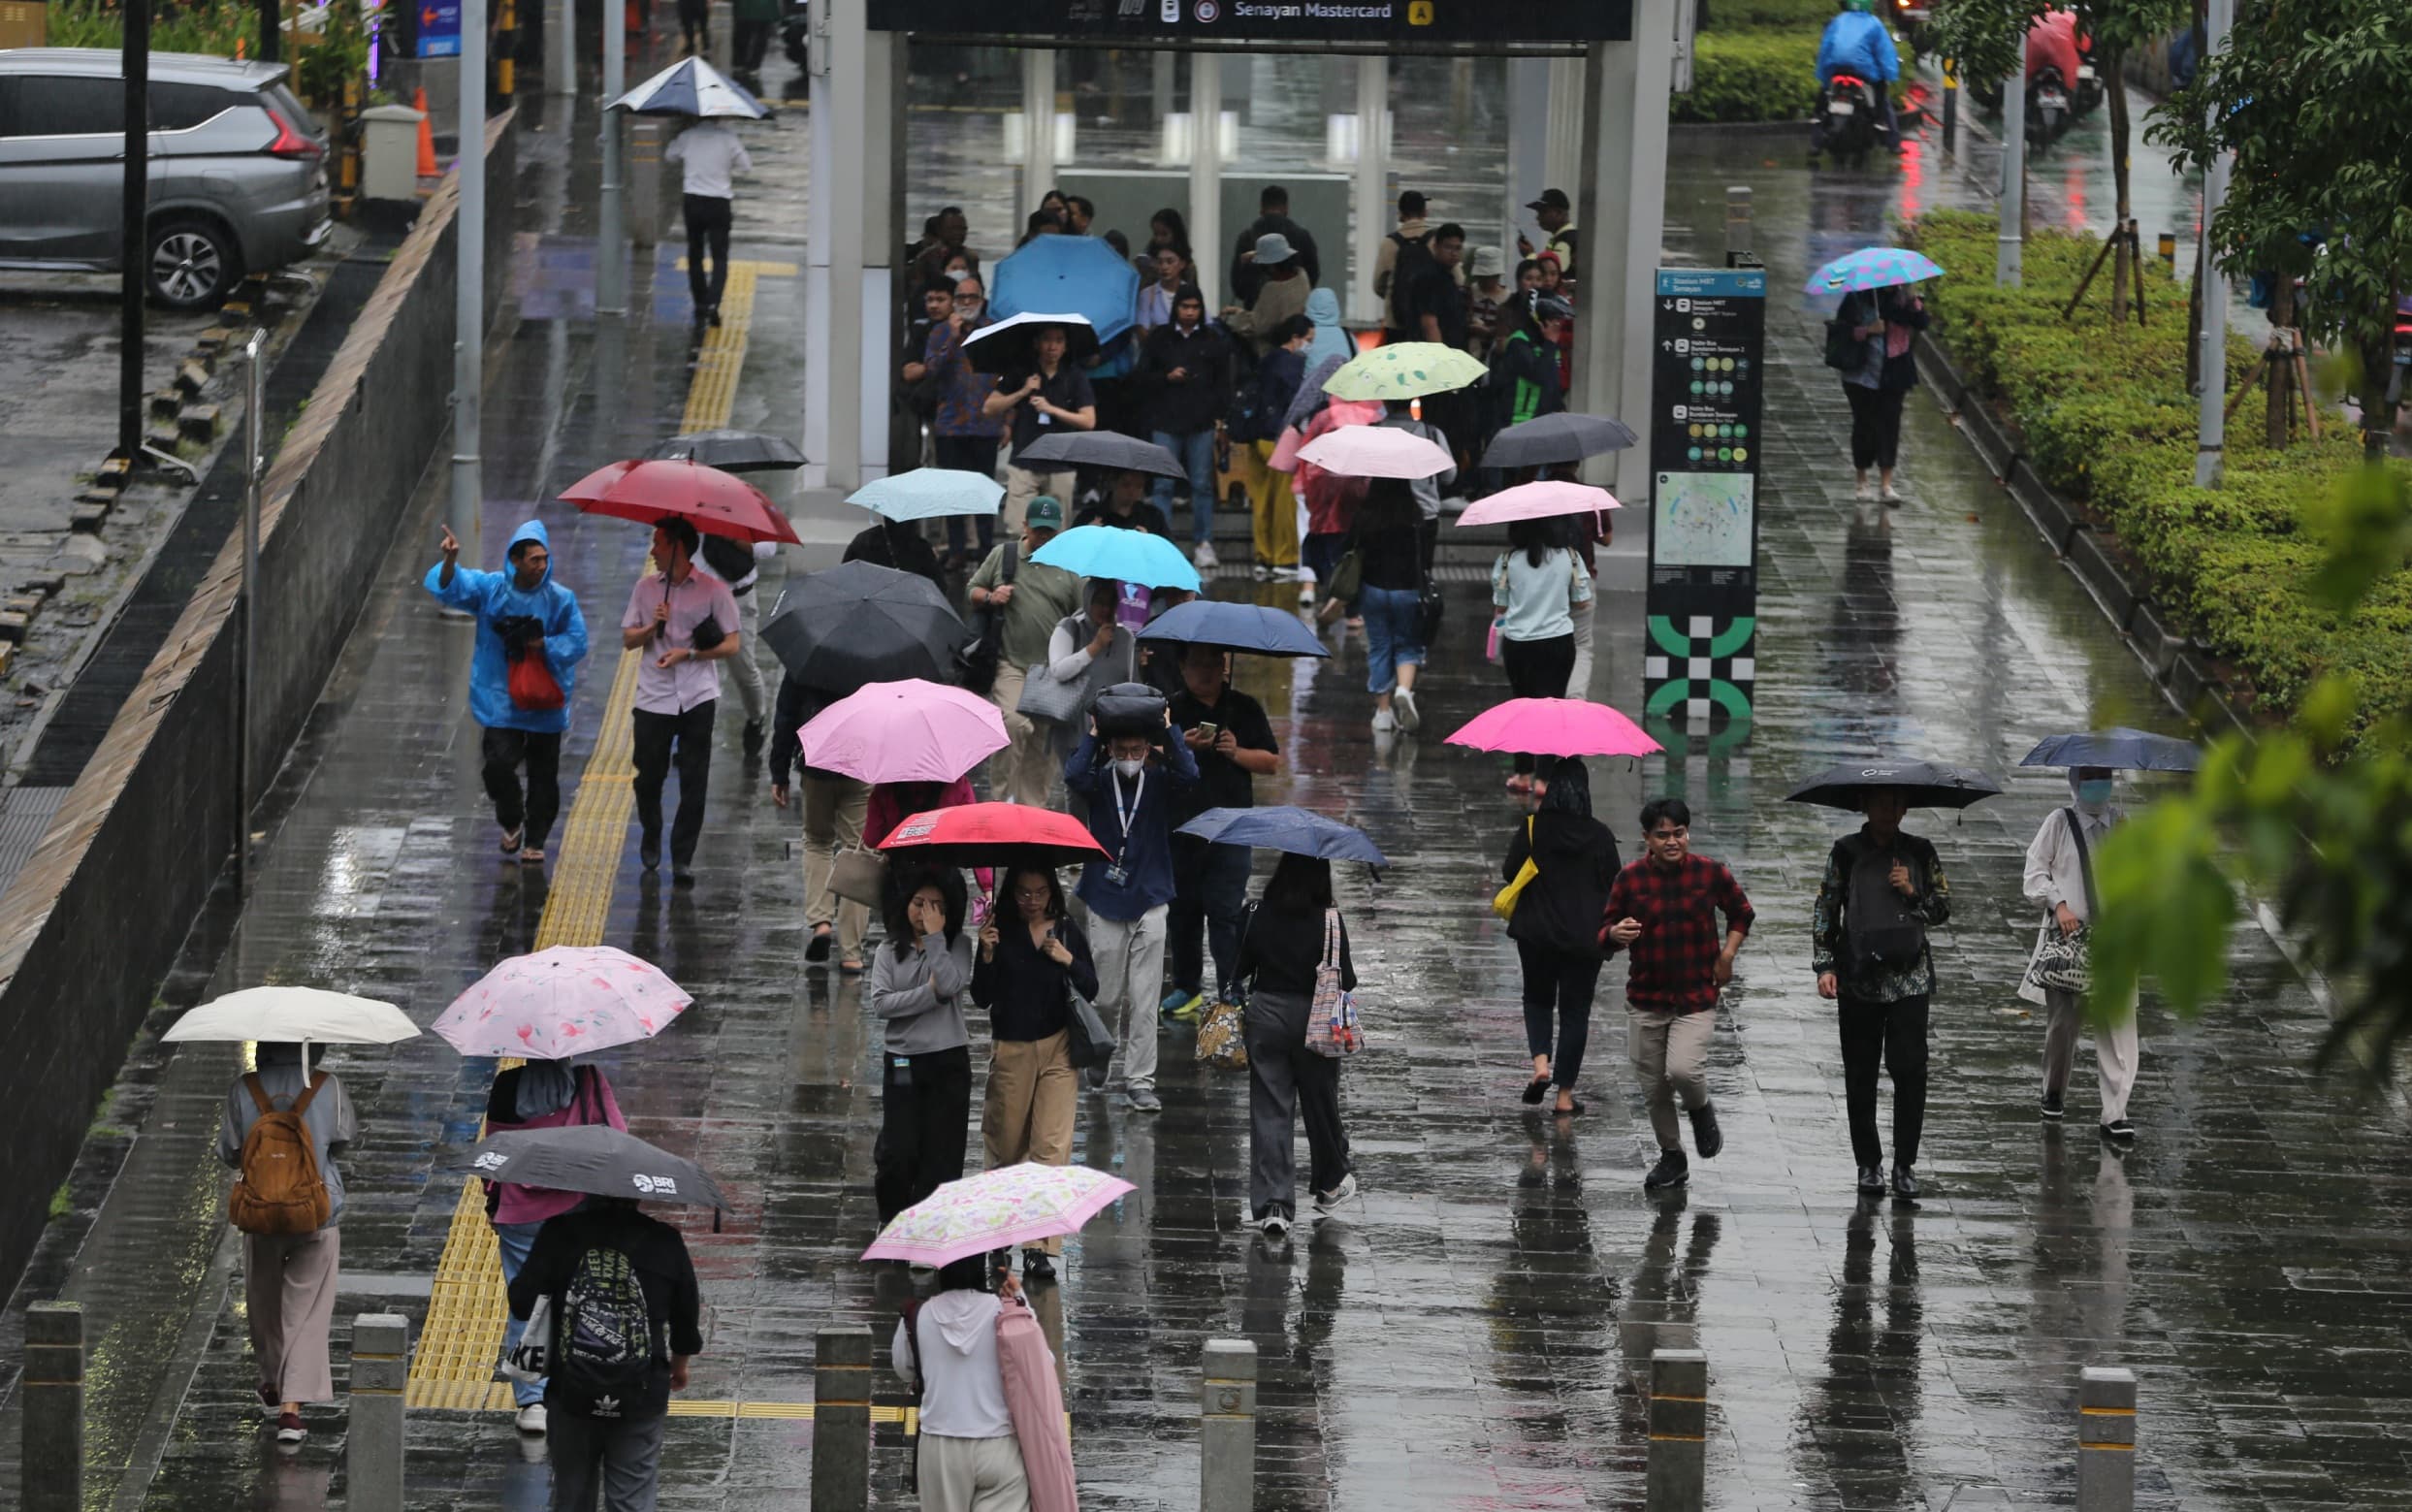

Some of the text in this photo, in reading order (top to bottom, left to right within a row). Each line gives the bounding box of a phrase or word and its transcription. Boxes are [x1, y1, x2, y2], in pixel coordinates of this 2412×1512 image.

[1235, 2, 1392, 19] Senayan Mastercard
[1415, 7, 1427, 19] A
[652, 1175, 676, 1189] BRI
